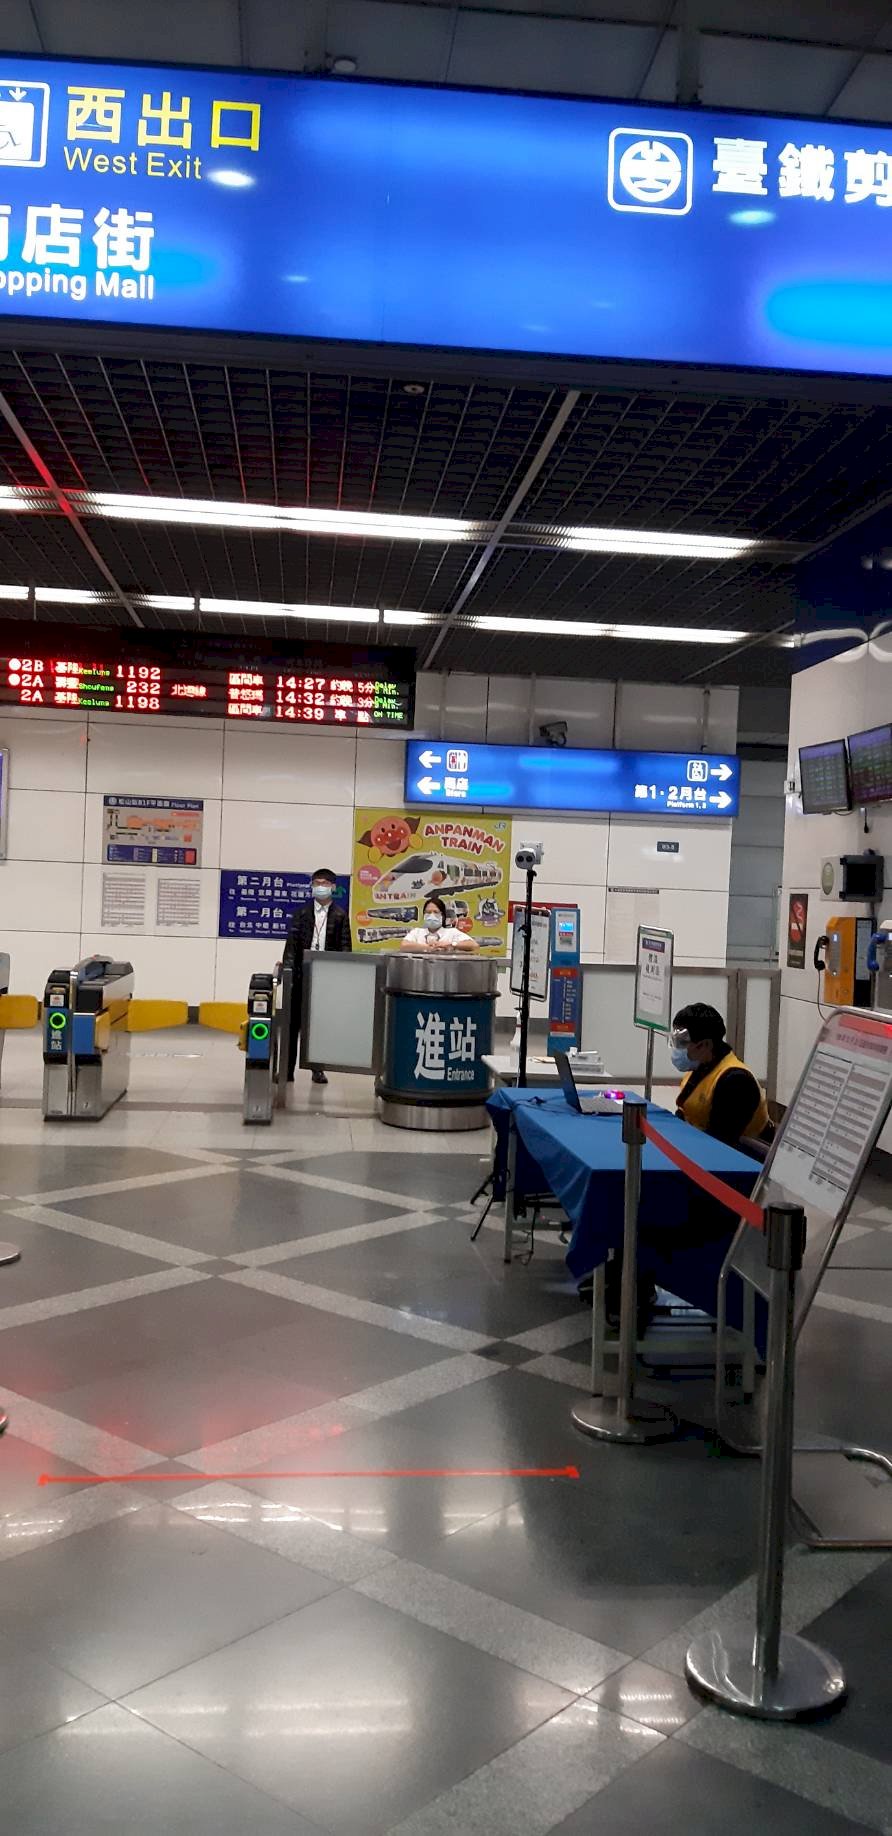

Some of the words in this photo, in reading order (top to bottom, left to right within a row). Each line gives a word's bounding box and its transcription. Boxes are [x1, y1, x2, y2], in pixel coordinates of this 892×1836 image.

[67, 86, 261, 151] 西出口
[63, 147, 137, 176] West
[147, 152, 202, 180] Exit
[0, 203, 155, 272] 店街
[95, 271, 154, 300] Mall
[21, 659, 44, 673] 2B
[117, 665, 161, 680] 1192
[229, 673, 263, 686] 區間車
[276, 676, 326, 690] 14:27
[21, 674, 44, 688] 2A
[126, 682, 161, 695] 232
[276, 691, 325, 706] 14:32
[20, 690, 43, 703] 2A
[115, 696, 160, 709] 1198
[228, 703, 262, 715] 區間車
[276, 706, 324, 720] 14:39
[667, 800, 694, 808] Platform
[424, 824, 504, 852] ANPANMAN
[442, 837, 484, 855] TRAIN
[237, 876, 283, 888] 第二月台
[236, 907, 283, 918] 第一月台
[413, 1011, 477, 1080] 進站
[447, 1067, 475, 1081] Entrance
